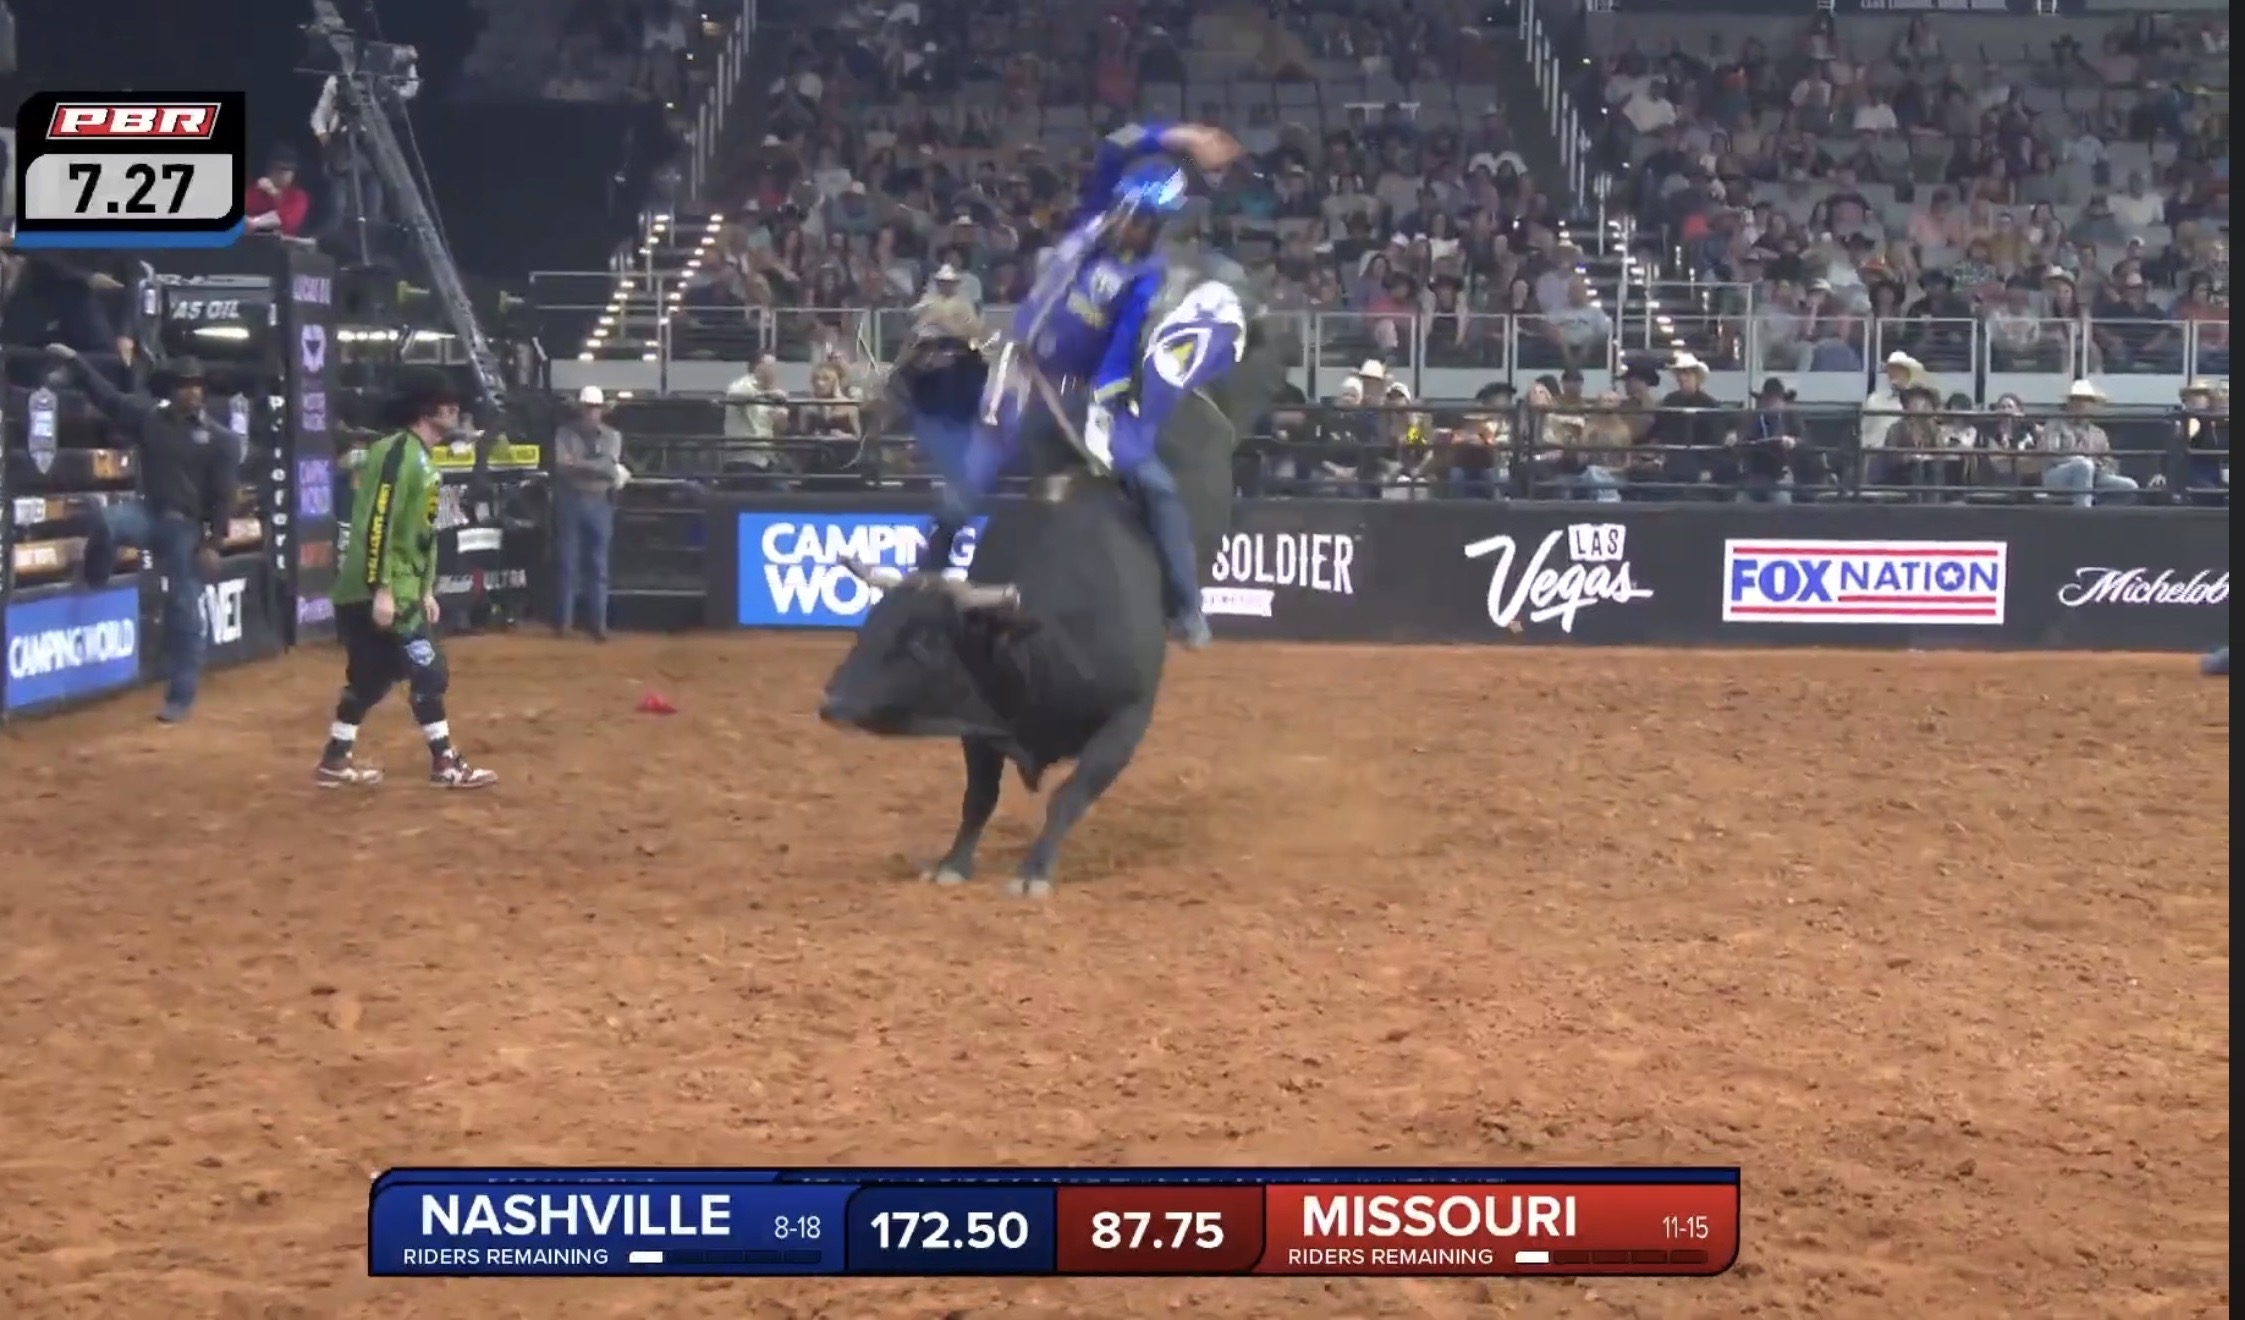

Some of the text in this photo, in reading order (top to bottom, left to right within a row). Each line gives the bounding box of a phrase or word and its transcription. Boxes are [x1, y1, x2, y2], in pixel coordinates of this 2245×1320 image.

[1212, 533, 1354, 594] SOLDIER
[1573, 526, 1622, 558] LAS
[1465, 530, 1654, 632] Vegas
[1731, 559, 1998, 602] FOX NATION
[2058, 566, 2229, 606] Michelob
